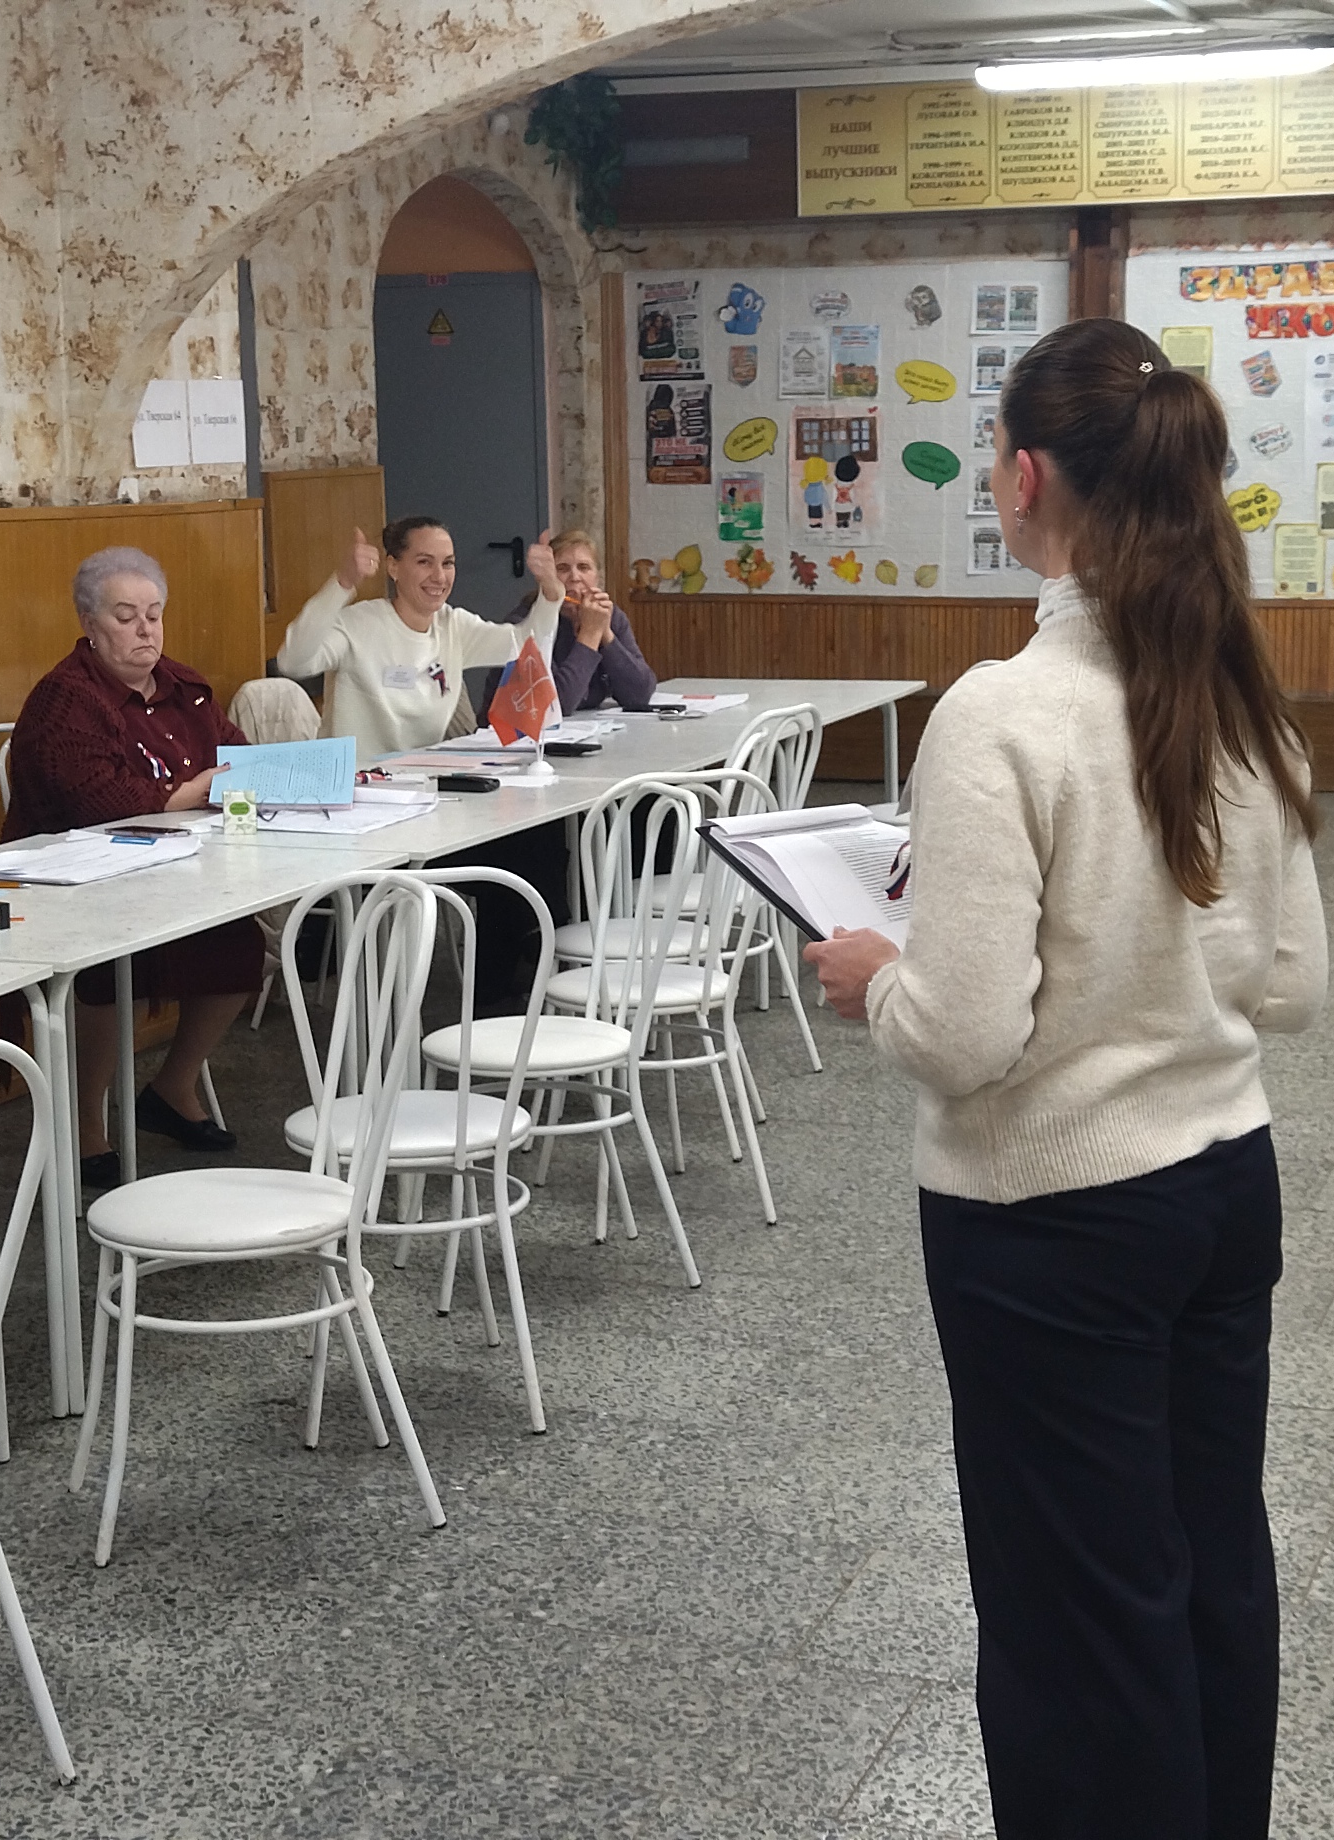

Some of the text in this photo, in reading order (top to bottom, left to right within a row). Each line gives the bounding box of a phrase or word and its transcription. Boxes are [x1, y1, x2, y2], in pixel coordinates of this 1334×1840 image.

[830, 121, 872, 134] НАШИ
[822, 143, 881, 158] ЛУЧШИЕ
[805, 165, 897, 181] ВЫПУСКНИКИ
